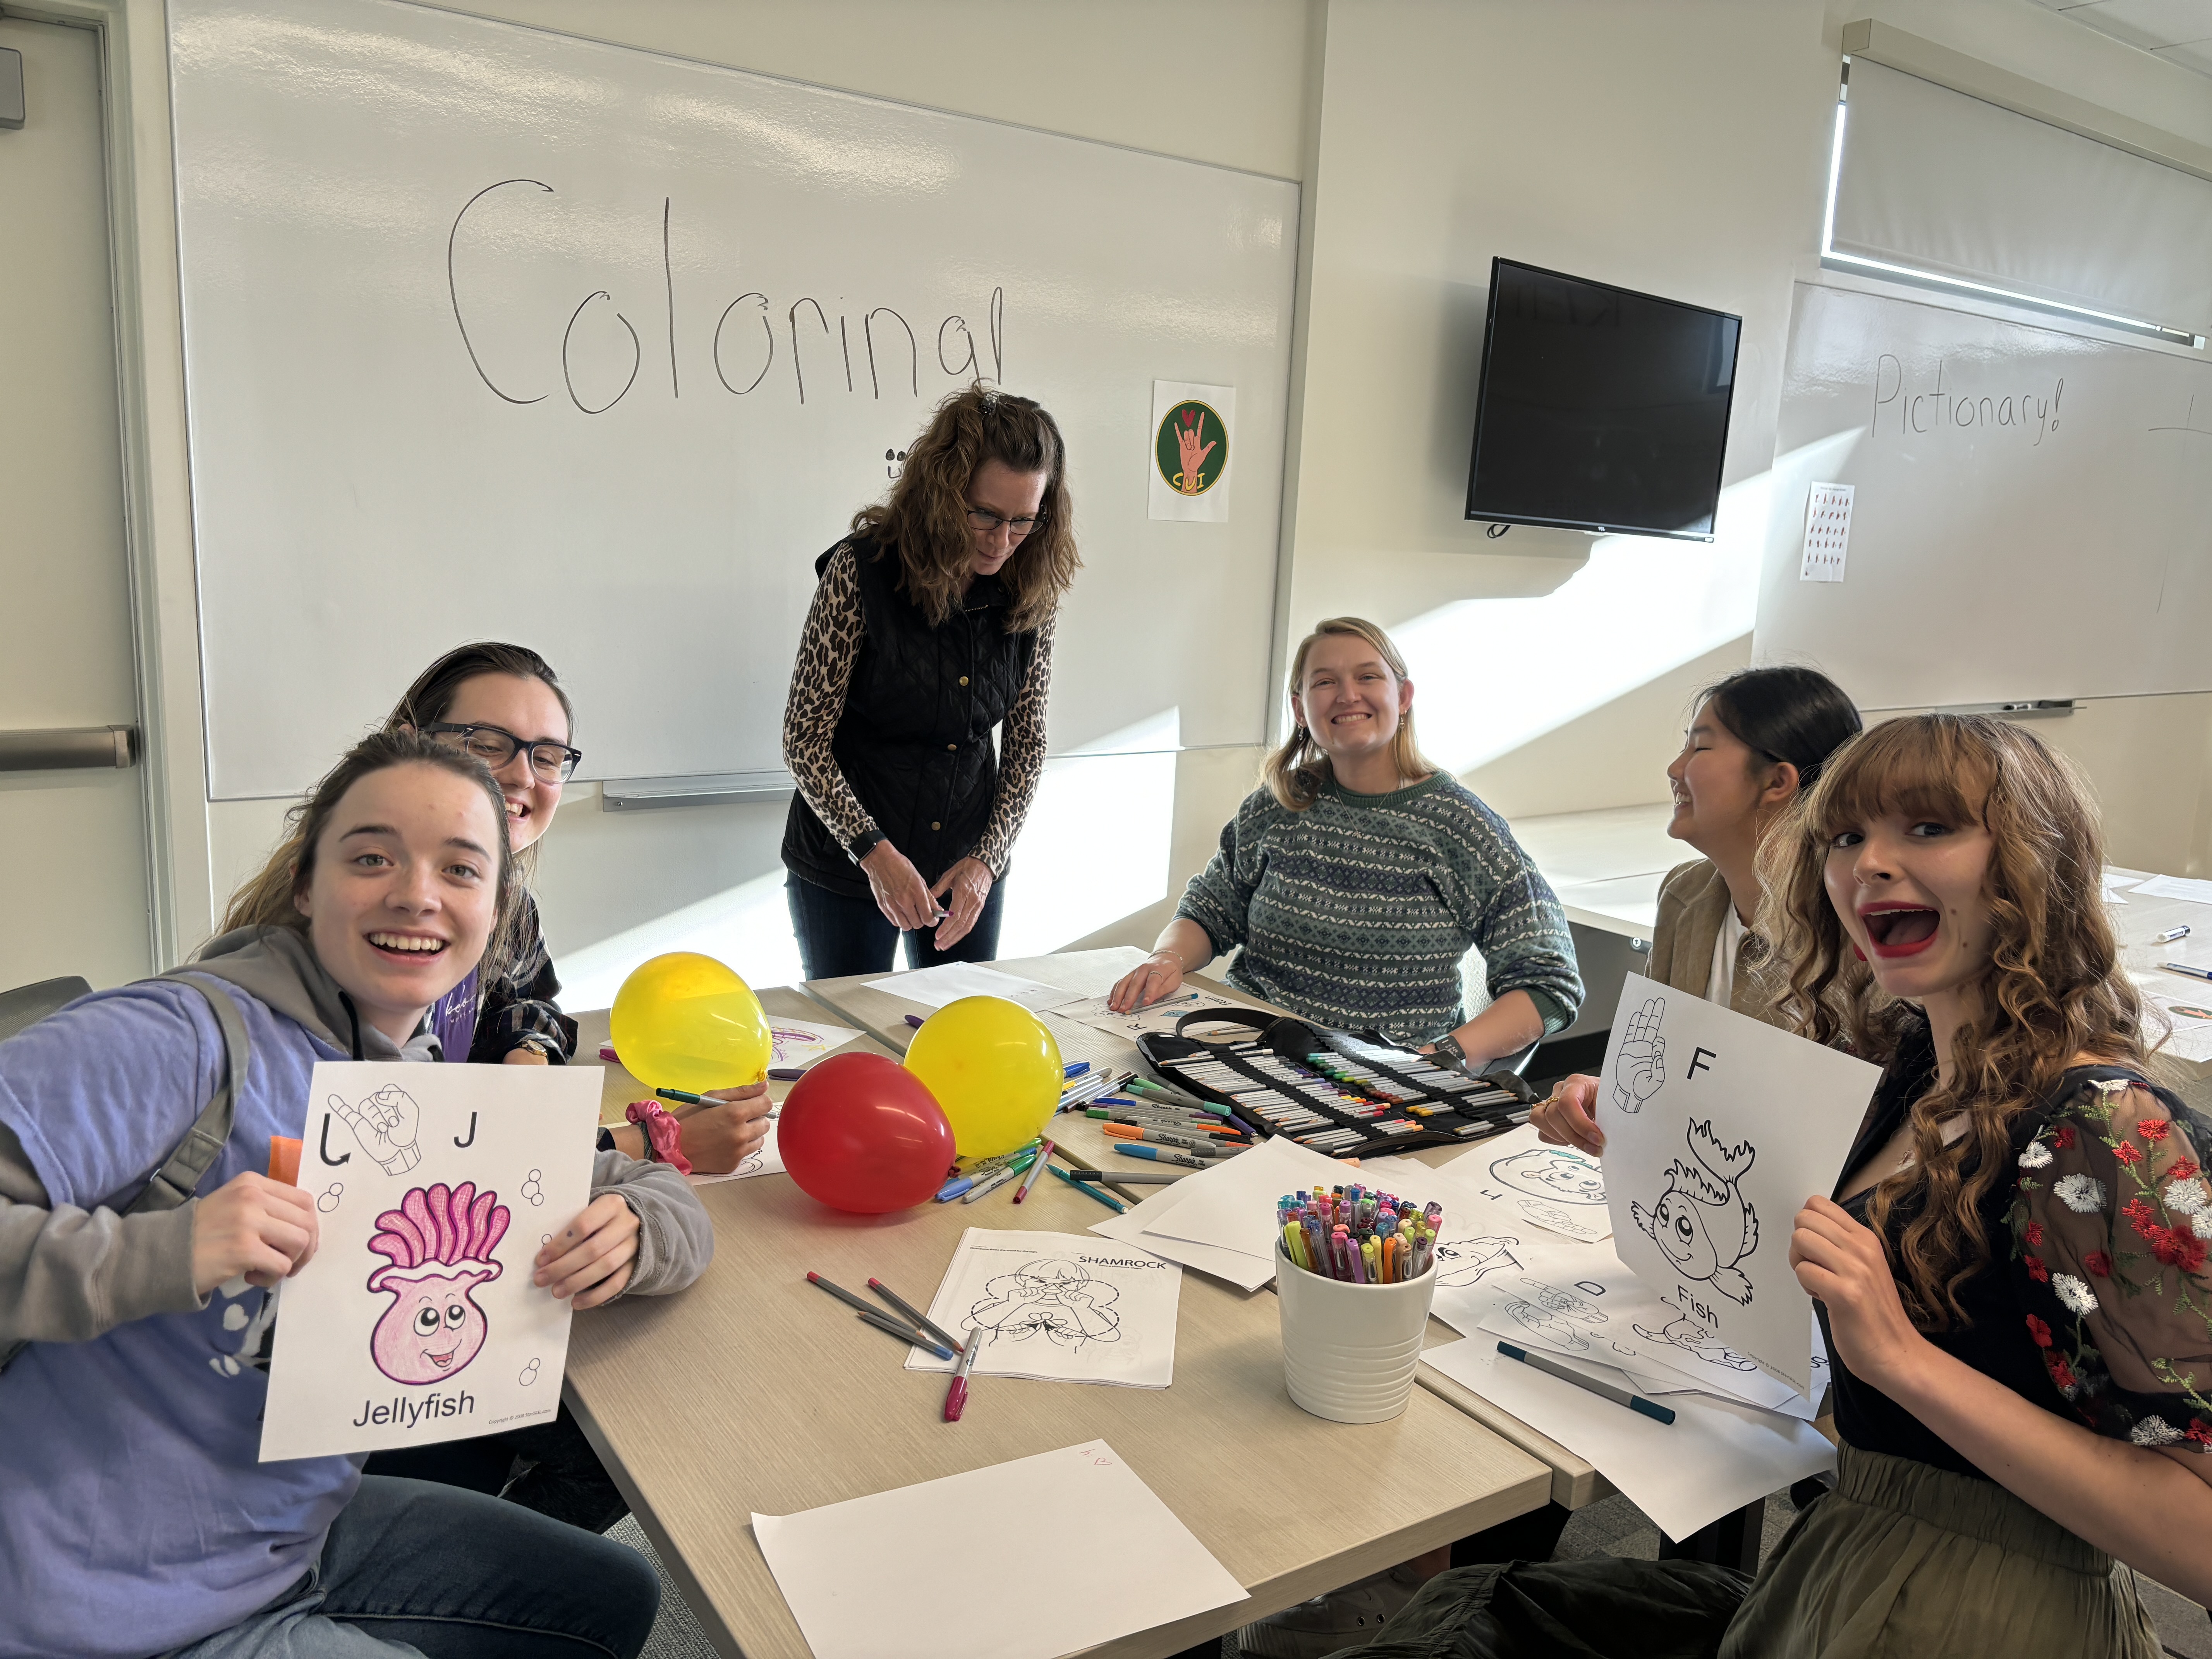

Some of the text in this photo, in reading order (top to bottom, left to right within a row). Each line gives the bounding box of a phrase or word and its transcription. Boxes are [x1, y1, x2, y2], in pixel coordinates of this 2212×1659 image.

[1872, 354, 2064, 446] Pictionary!
[1173, 472, 1206, 491] CUI
[1204, 996, 1232, 1006] Rain
[1686, 1046, 1717, 1080] F
[454, 1111, 477, 1148] J
[1078, 1256, 1166, 1269] SHAMROCK
[1573, 1281, 1606, 1296] D
[1677, 1283, 1719, 1329] Fish
[353, 1390, 475, 1429] Jellyfish
